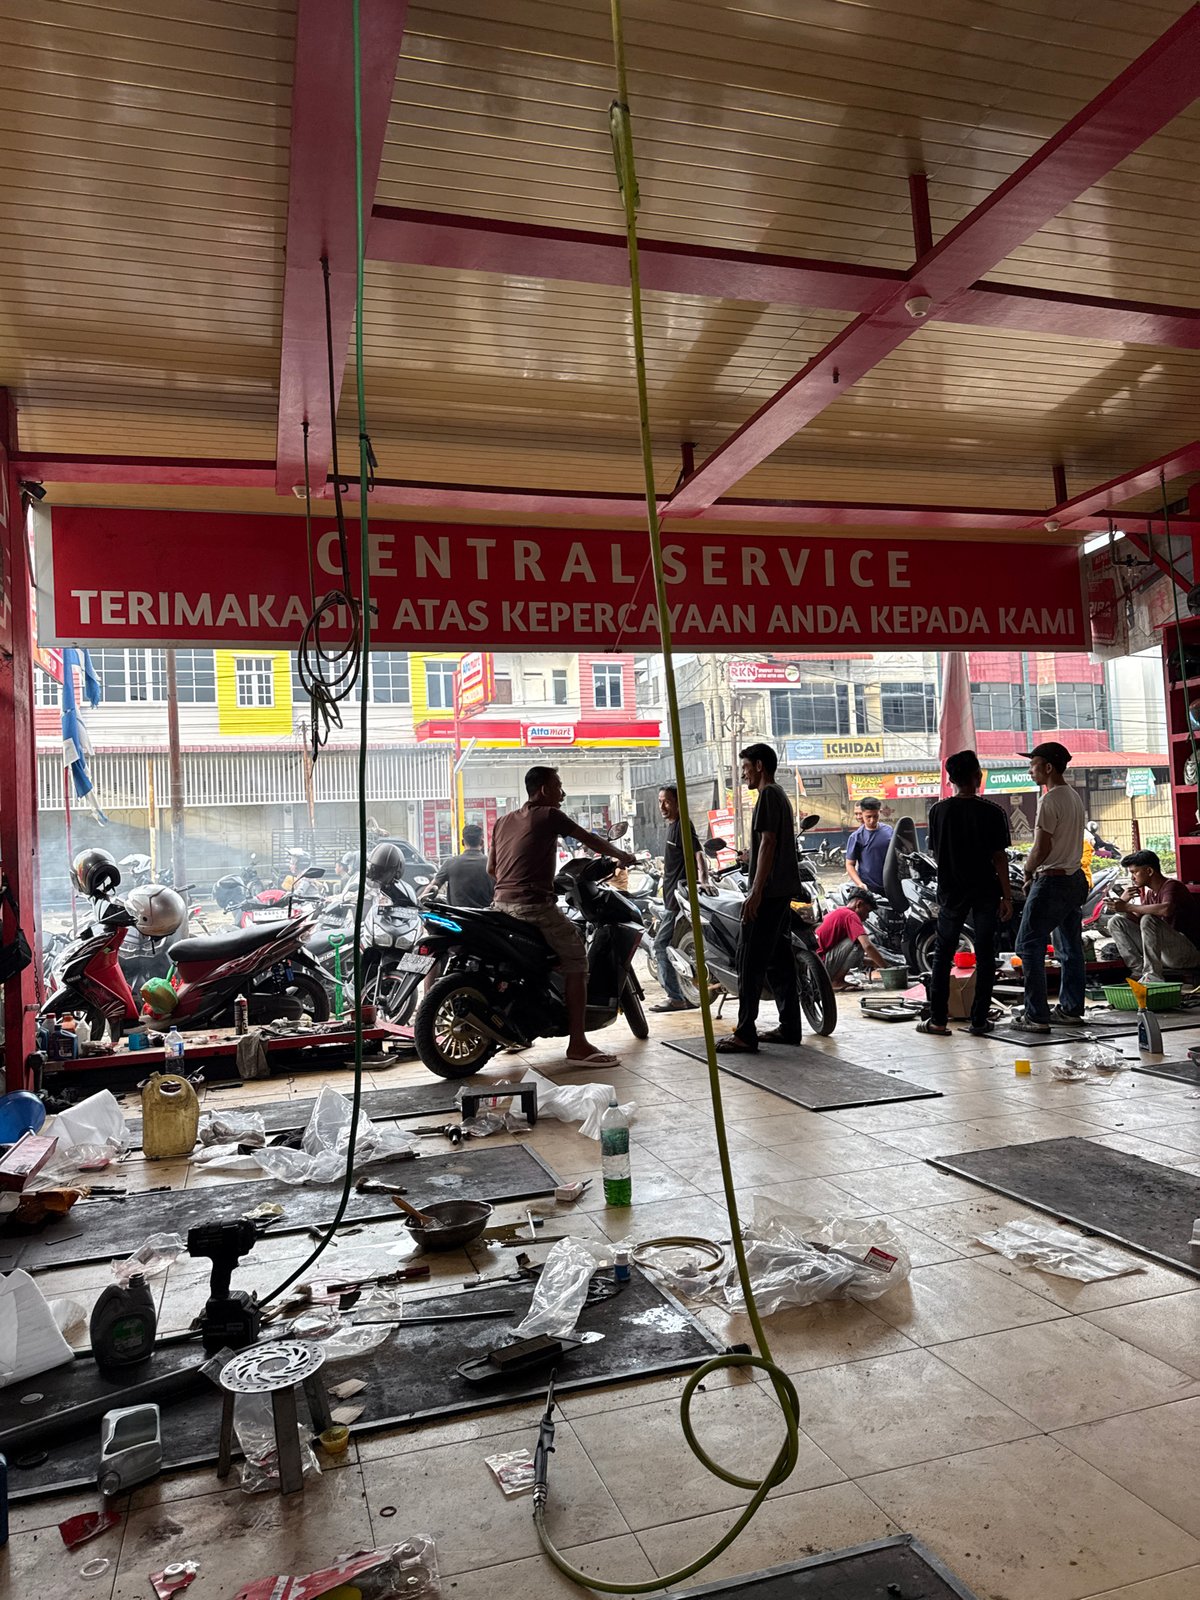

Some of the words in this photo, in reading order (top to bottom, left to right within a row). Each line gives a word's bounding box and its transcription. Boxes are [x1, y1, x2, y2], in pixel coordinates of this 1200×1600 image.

[316, 531, 635, 585] CENTRAL
[662, 545, 911, 588] SERVICE
[393, 598, 489, 632] ATAS
[502, 600, 756, 634] KEPERCAYAAN
[767, 604, 860, 635] ANDA
[870, 605, 991, 635] KEPADA
[1000, 608, 1075, 635] KAMI
[730, 667, 756, 678] RKN
[531, 727, 571, 736] Alfamart
[827, 742, 880, 754] ICHIDAI
[990, 774, 1011, 783] CITRA
[1012, 773, 1033, 782] MOTO
